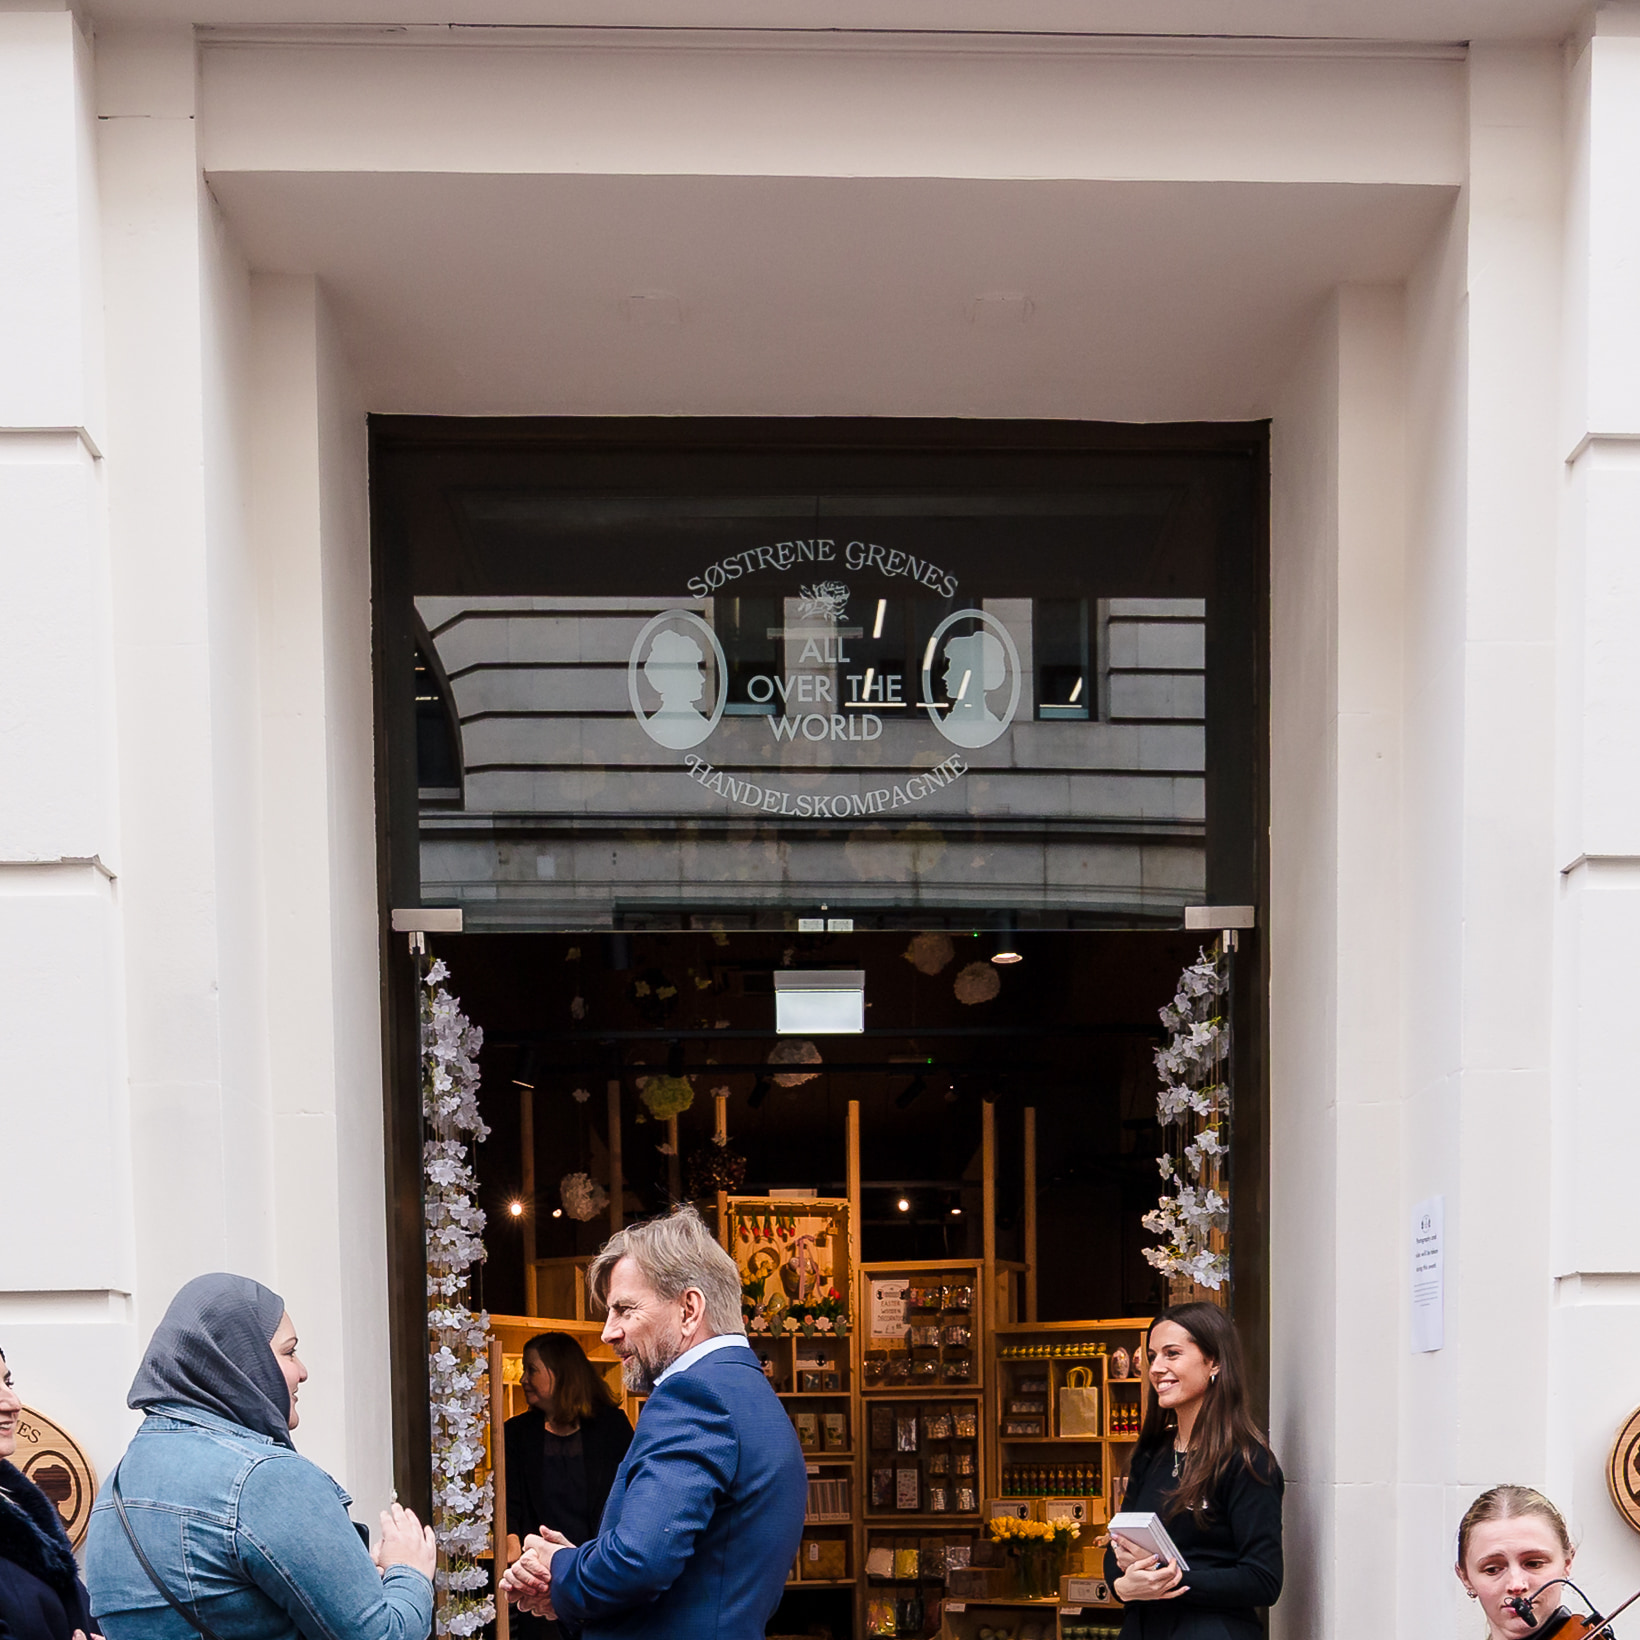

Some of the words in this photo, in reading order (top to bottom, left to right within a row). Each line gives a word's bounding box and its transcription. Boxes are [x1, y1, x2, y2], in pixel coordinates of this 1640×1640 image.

[686, 539, 837, 600] SØSTRENE
[845, 540, 960, 599] GRENES
[798, 635, 851, 664] ALL
[747, 674, 832, 703] OVER
[846, 674, 902, 703] THE
[767, 713, 883, 742] WORLD
[683, 752, 969, 818] HANDELSKOMPAGNIE
